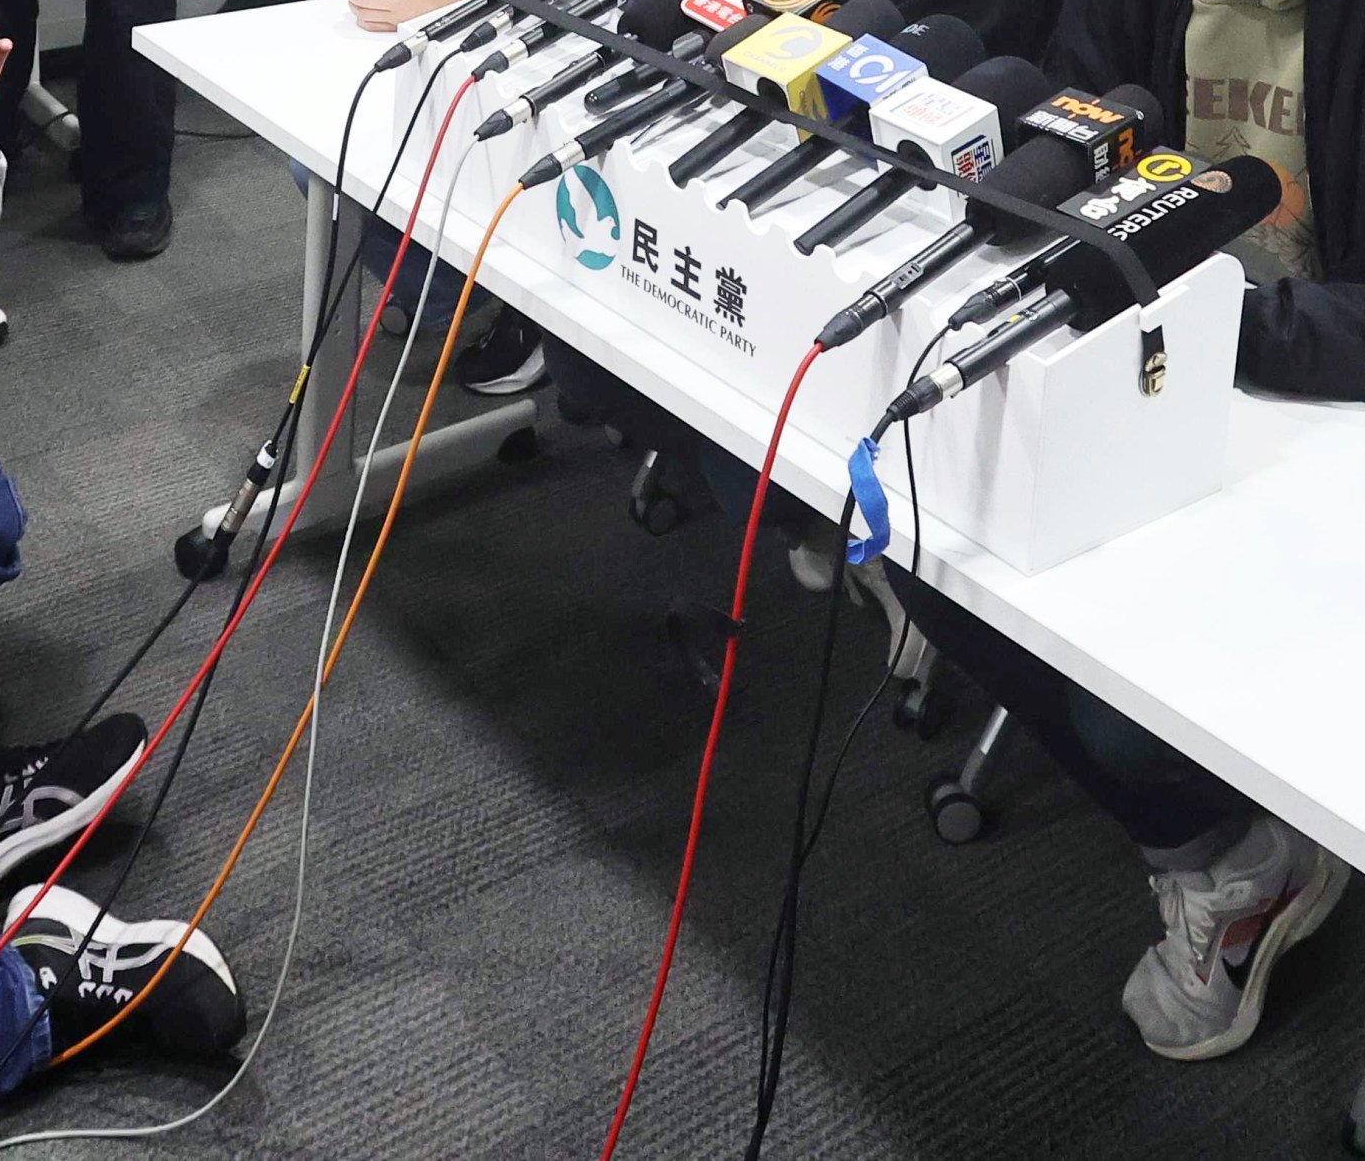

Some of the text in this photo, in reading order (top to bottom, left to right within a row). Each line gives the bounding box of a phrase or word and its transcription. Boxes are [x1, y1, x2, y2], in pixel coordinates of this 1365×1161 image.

[1050, 95, 1126, 124] now
[1107, 186, 1200, 242] REUTERS
[632, 218, 748, 328] 民主黨
[620, 264, 757, 358] THE DEMOCRATIC PARTY
